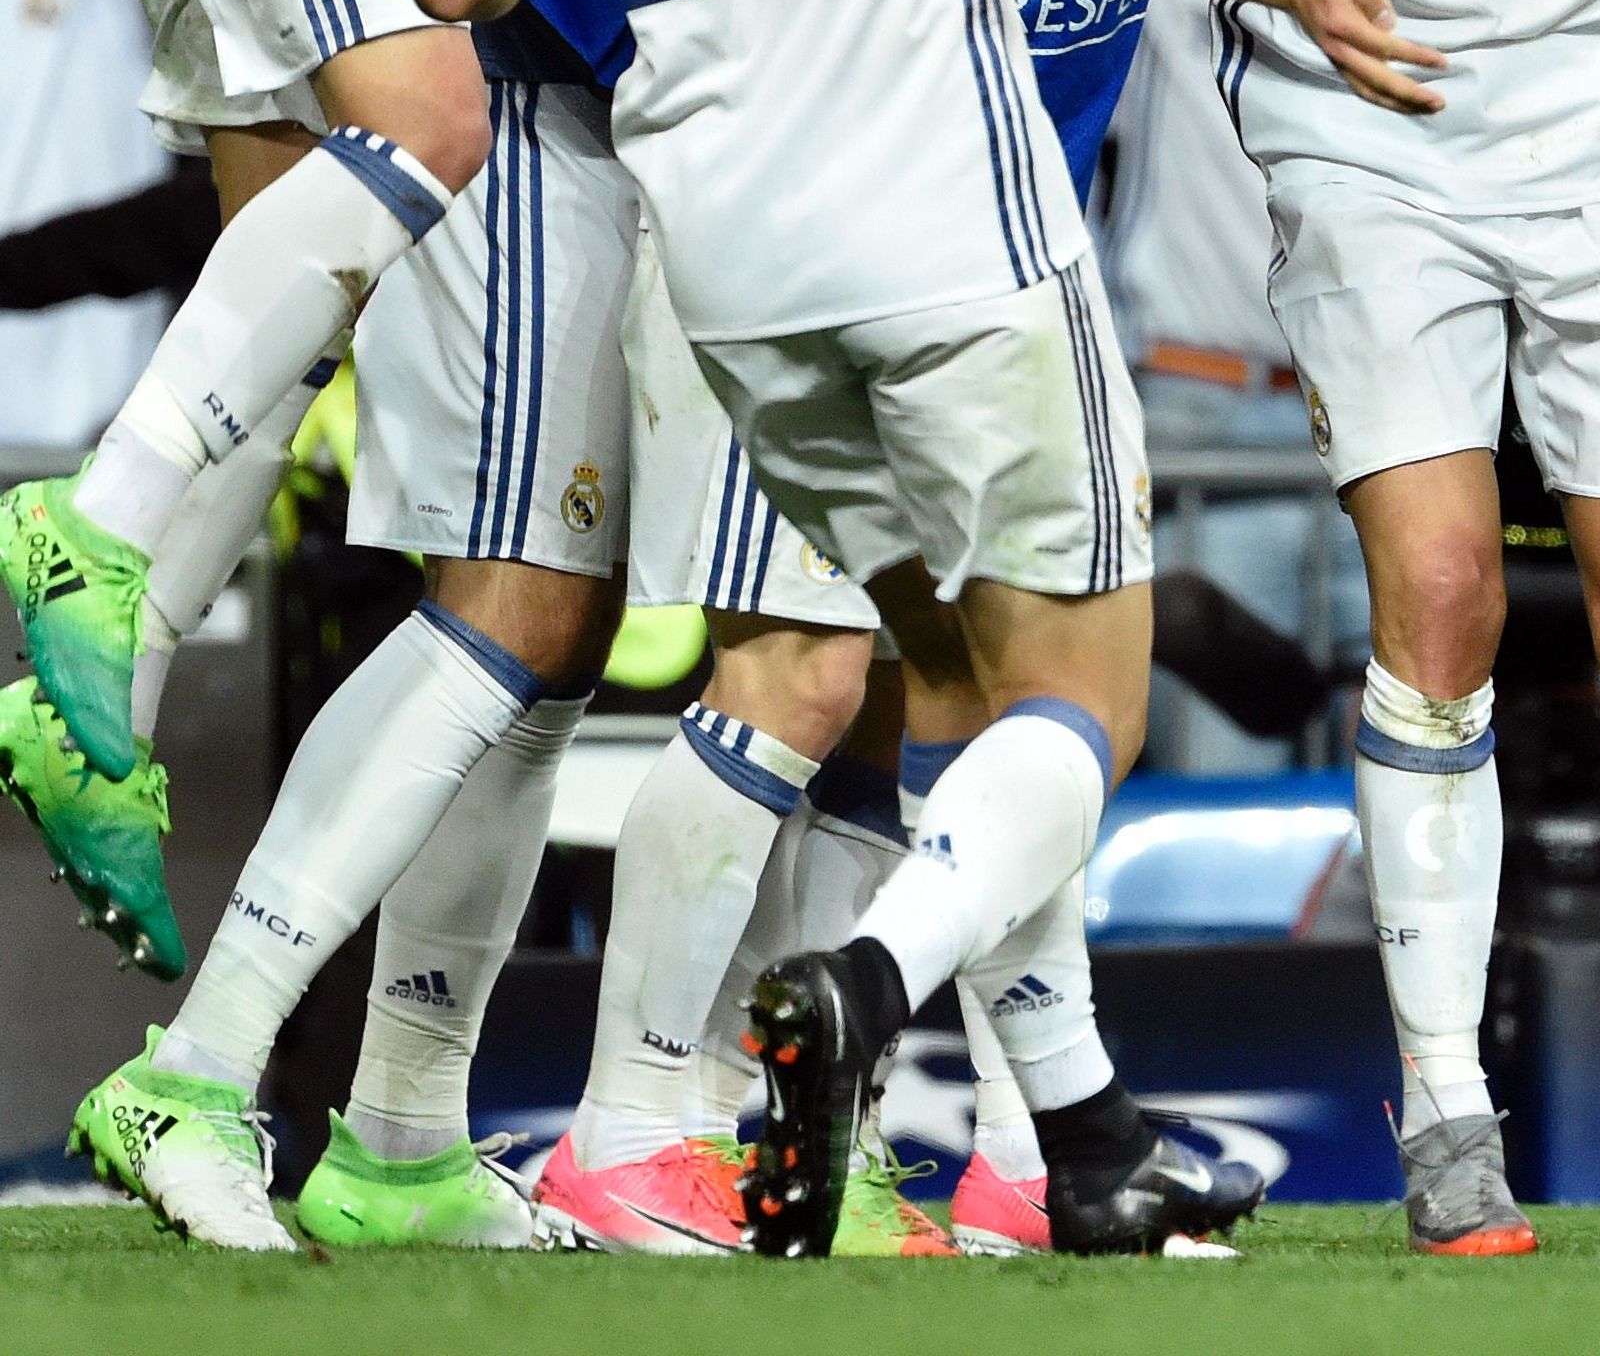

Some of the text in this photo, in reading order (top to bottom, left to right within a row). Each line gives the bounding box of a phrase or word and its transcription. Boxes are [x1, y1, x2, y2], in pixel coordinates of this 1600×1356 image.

[24, 532, 48, 625] adidas
[230, 891, 317, 947] RMCF
[385, 985, 456, 1009] adidas
[990, 991, 1064, 1018] adidas
[112, 1105, 146, 1179] adidas
